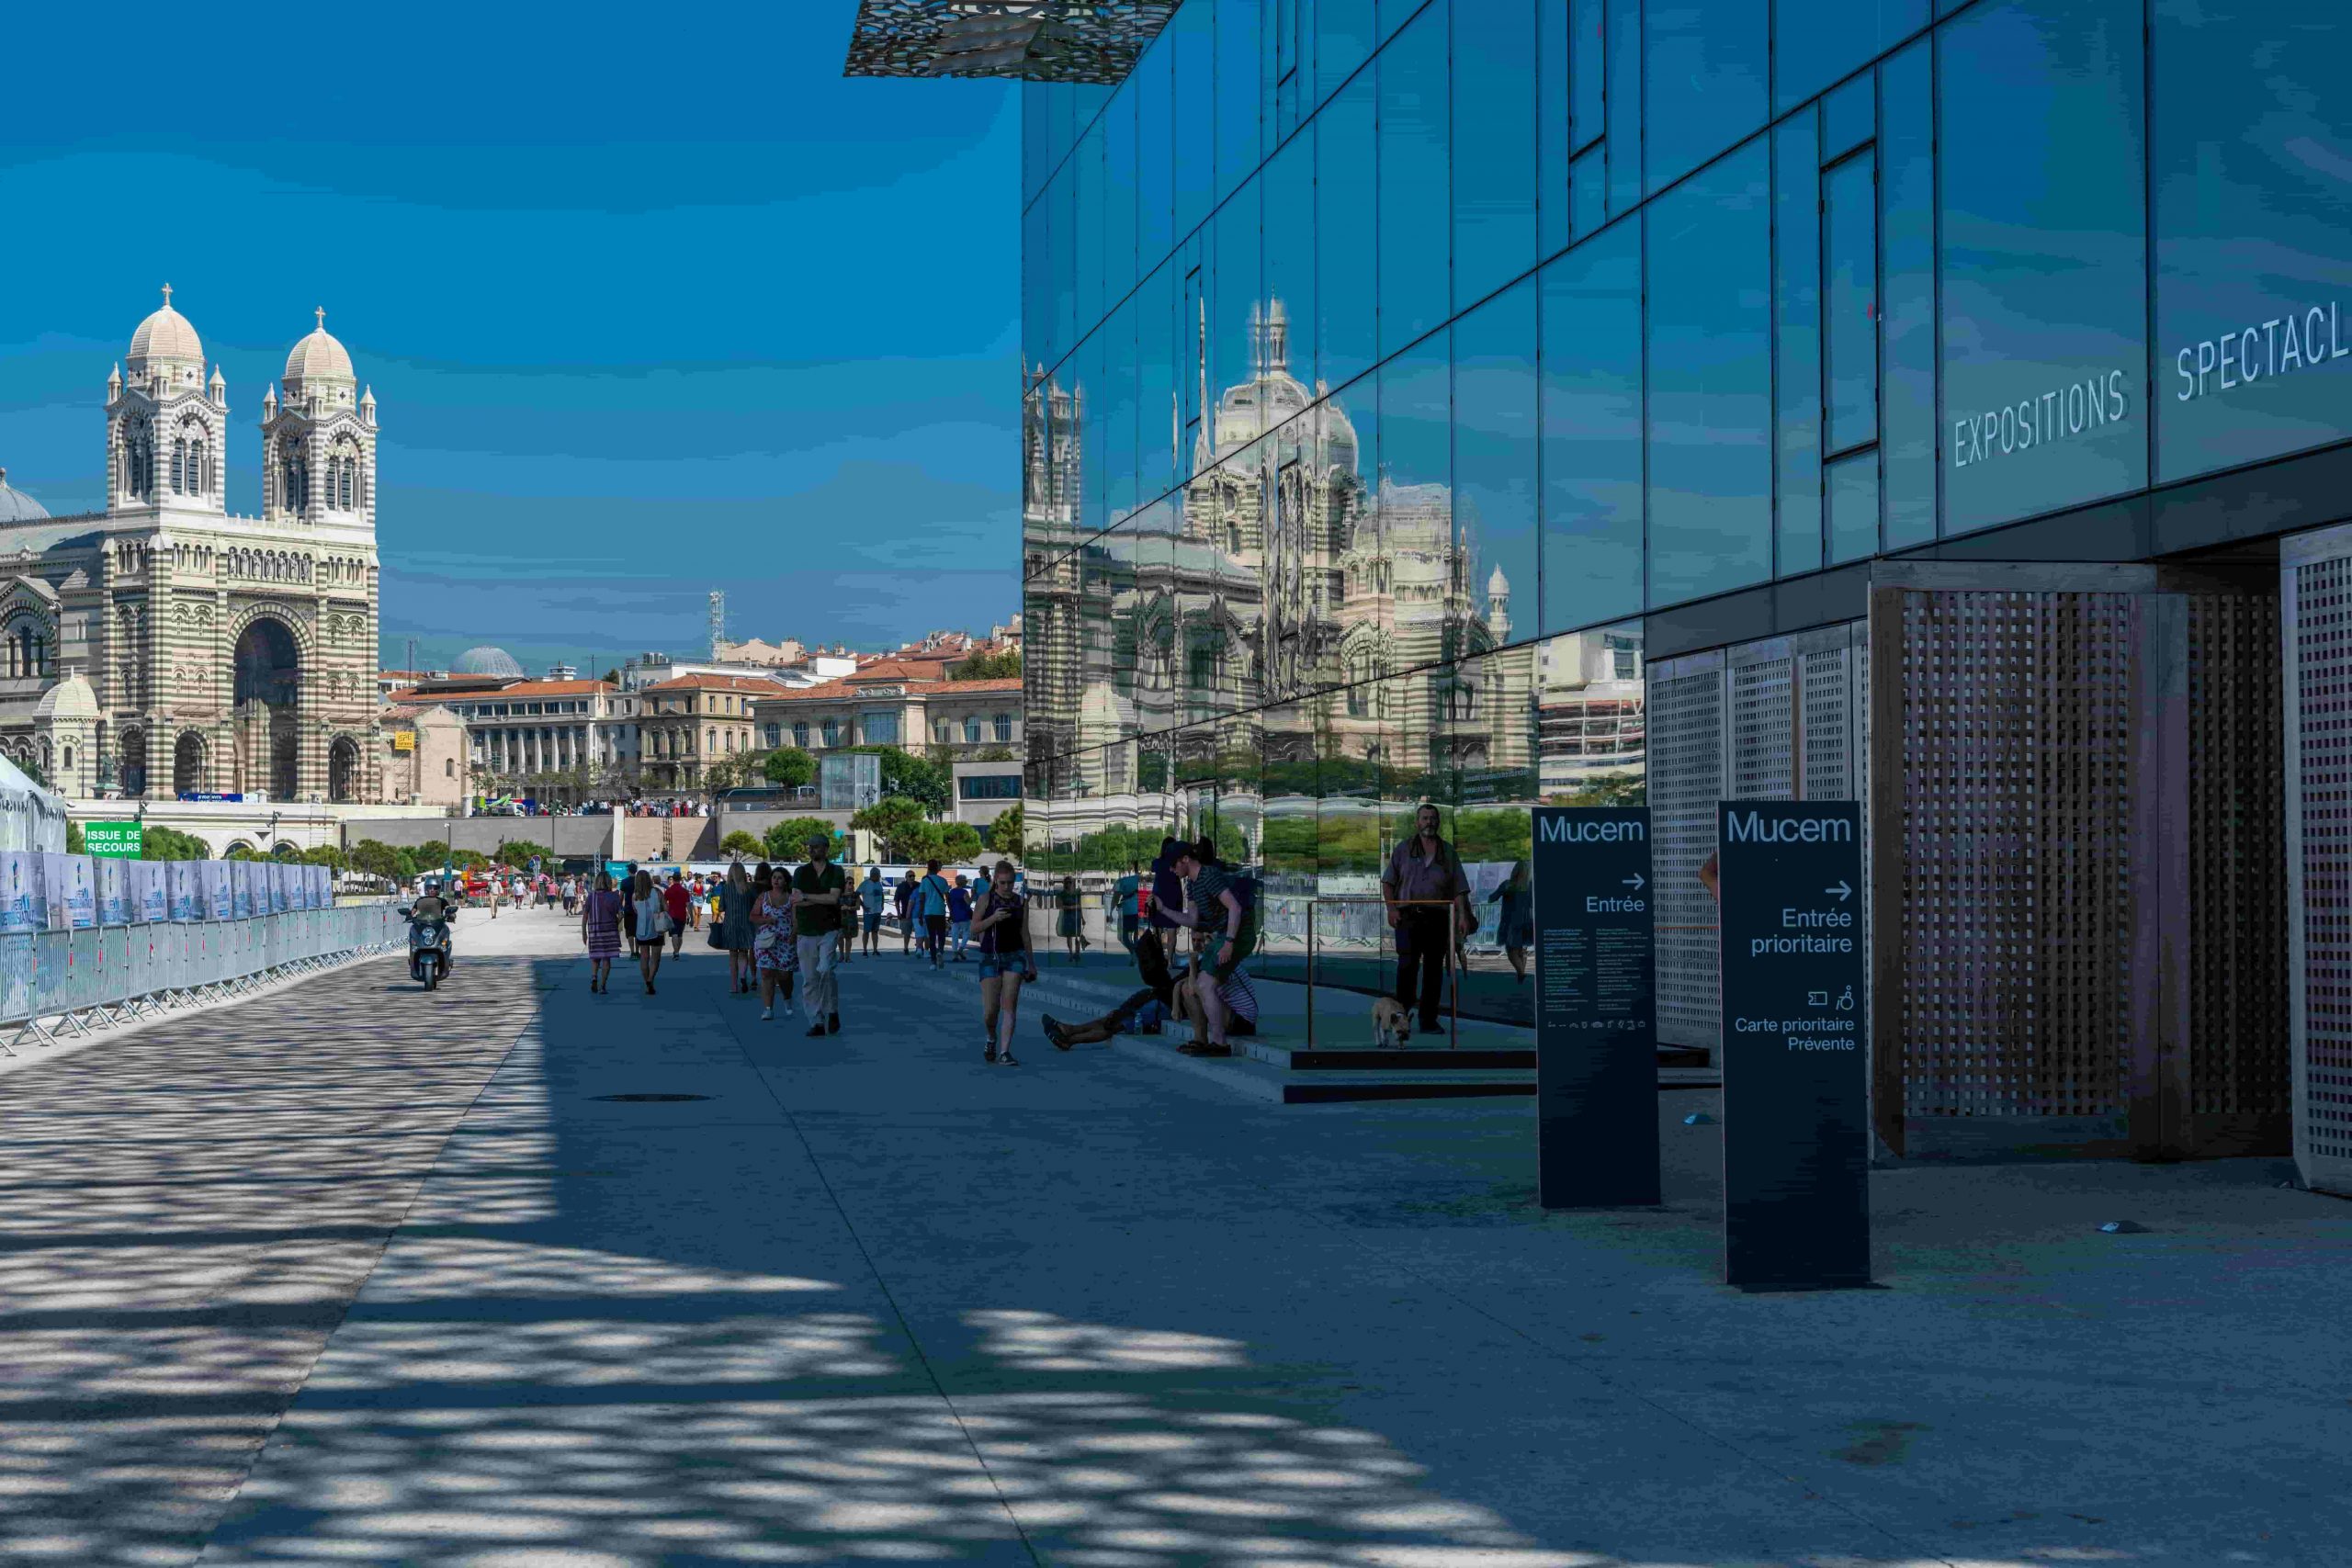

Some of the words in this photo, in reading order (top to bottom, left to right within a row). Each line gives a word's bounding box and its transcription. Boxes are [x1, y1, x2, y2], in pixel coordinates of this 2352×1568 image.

[1955, 369, 2124, 468] EXPOSITIONS
[87, 830, 121, 840] ISSUE
[126, 830, 141, 840] DE
[1540, 816, 1644, 842] Mucem
[1728, 810, 1851, 842] Mucem
[87, 842, 141, 852] SECOURS
[1586, 895, 1645, 913] Entrée
[1782, 908, 1852, 928] Entrée
[1751, 933, 1853, 958] prioritaire
[1735, 1017, 1779, 1032] Carte
[1781, 1017, 1855, 1035] prioritaire
[1788, 1036, 1855, 1051] Prévente
